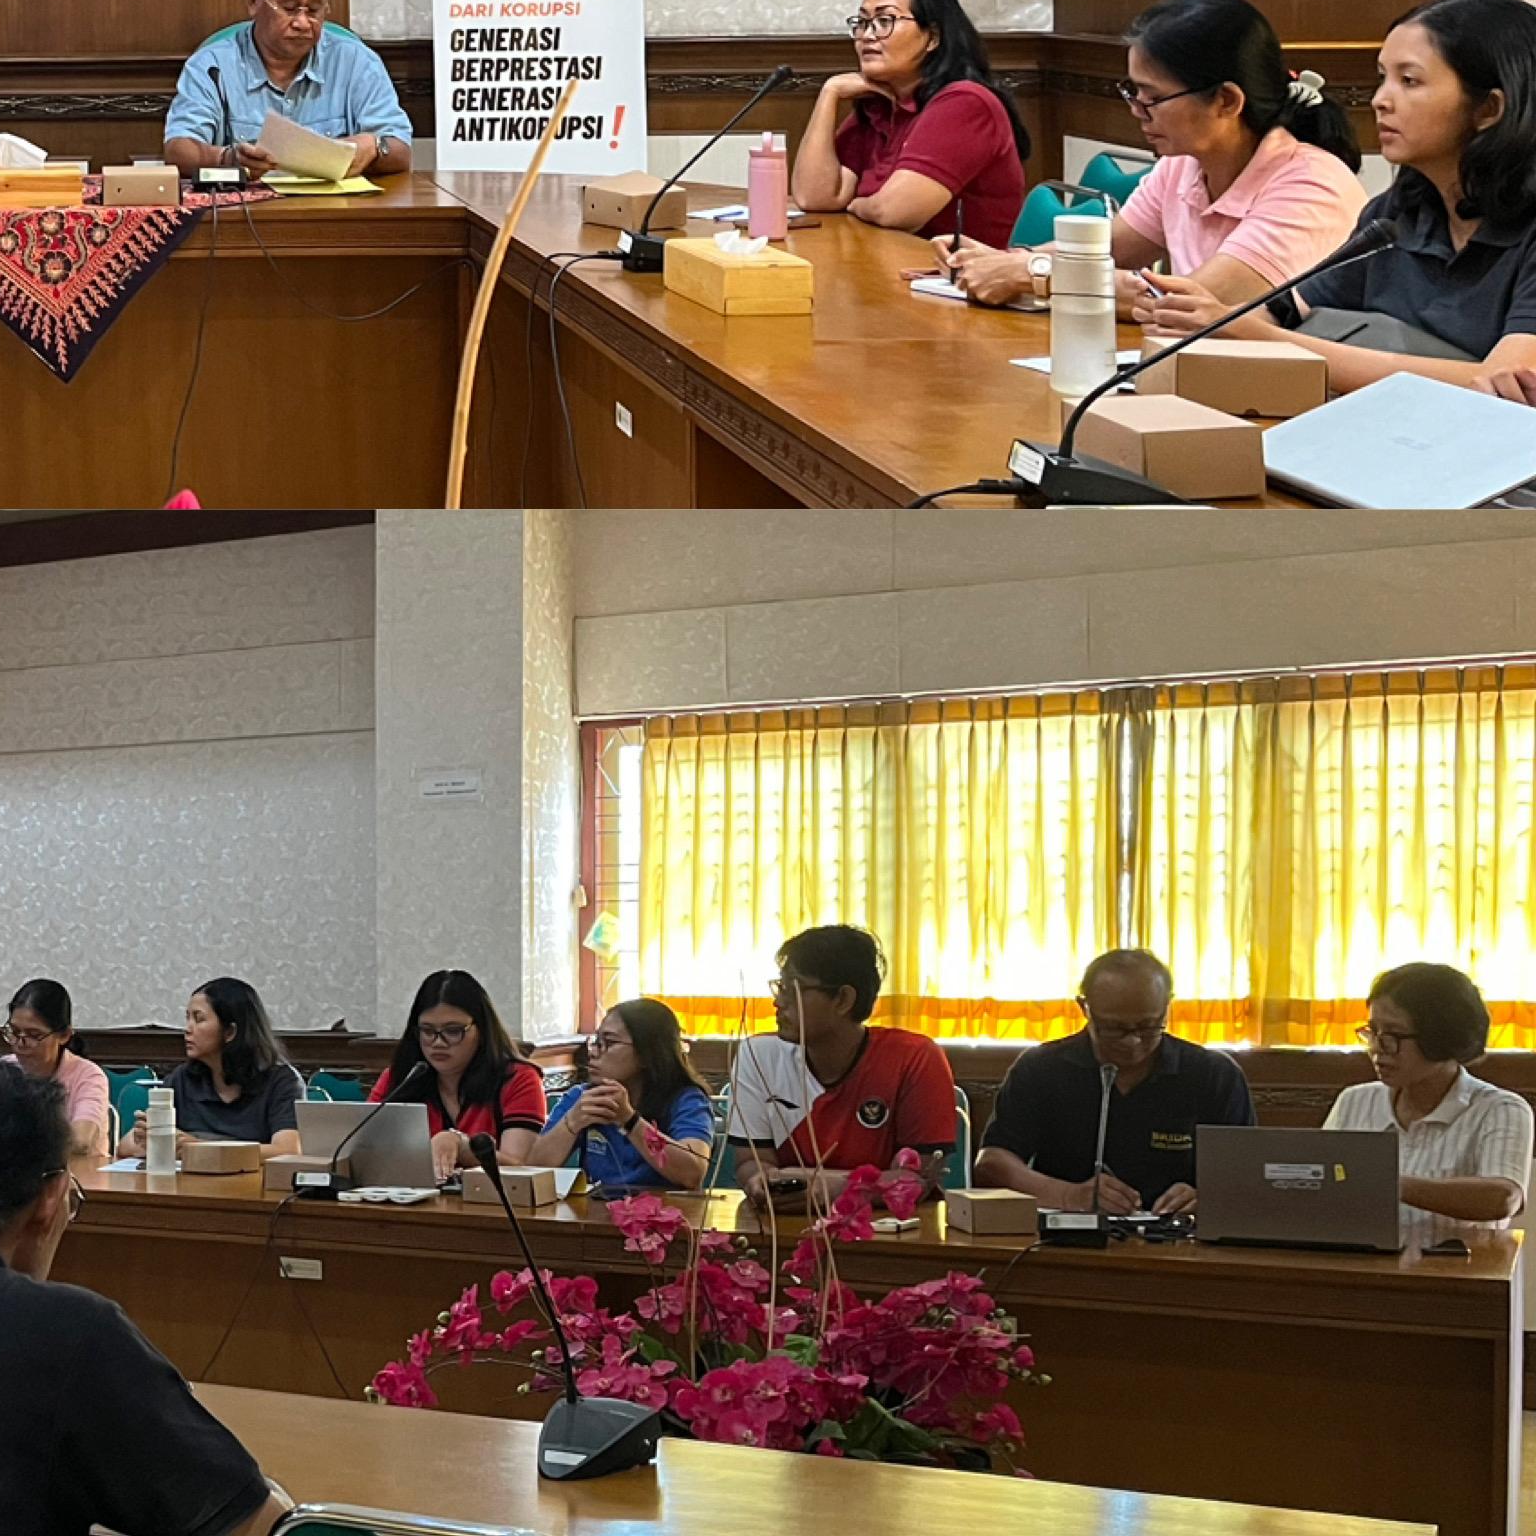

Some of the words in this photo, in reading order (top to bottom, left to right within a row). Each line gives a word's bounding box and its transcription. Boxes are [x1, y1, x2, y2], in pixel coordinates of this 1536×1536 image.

[450, 4, 493, 17] DARI
[499, 1, 581, 16] KORUPSI
[450, 27, 561, 52] GENERASI
[451, 56, 602, 82] BERPRESTASI
[451, 86, 562, 112] GENERASI
